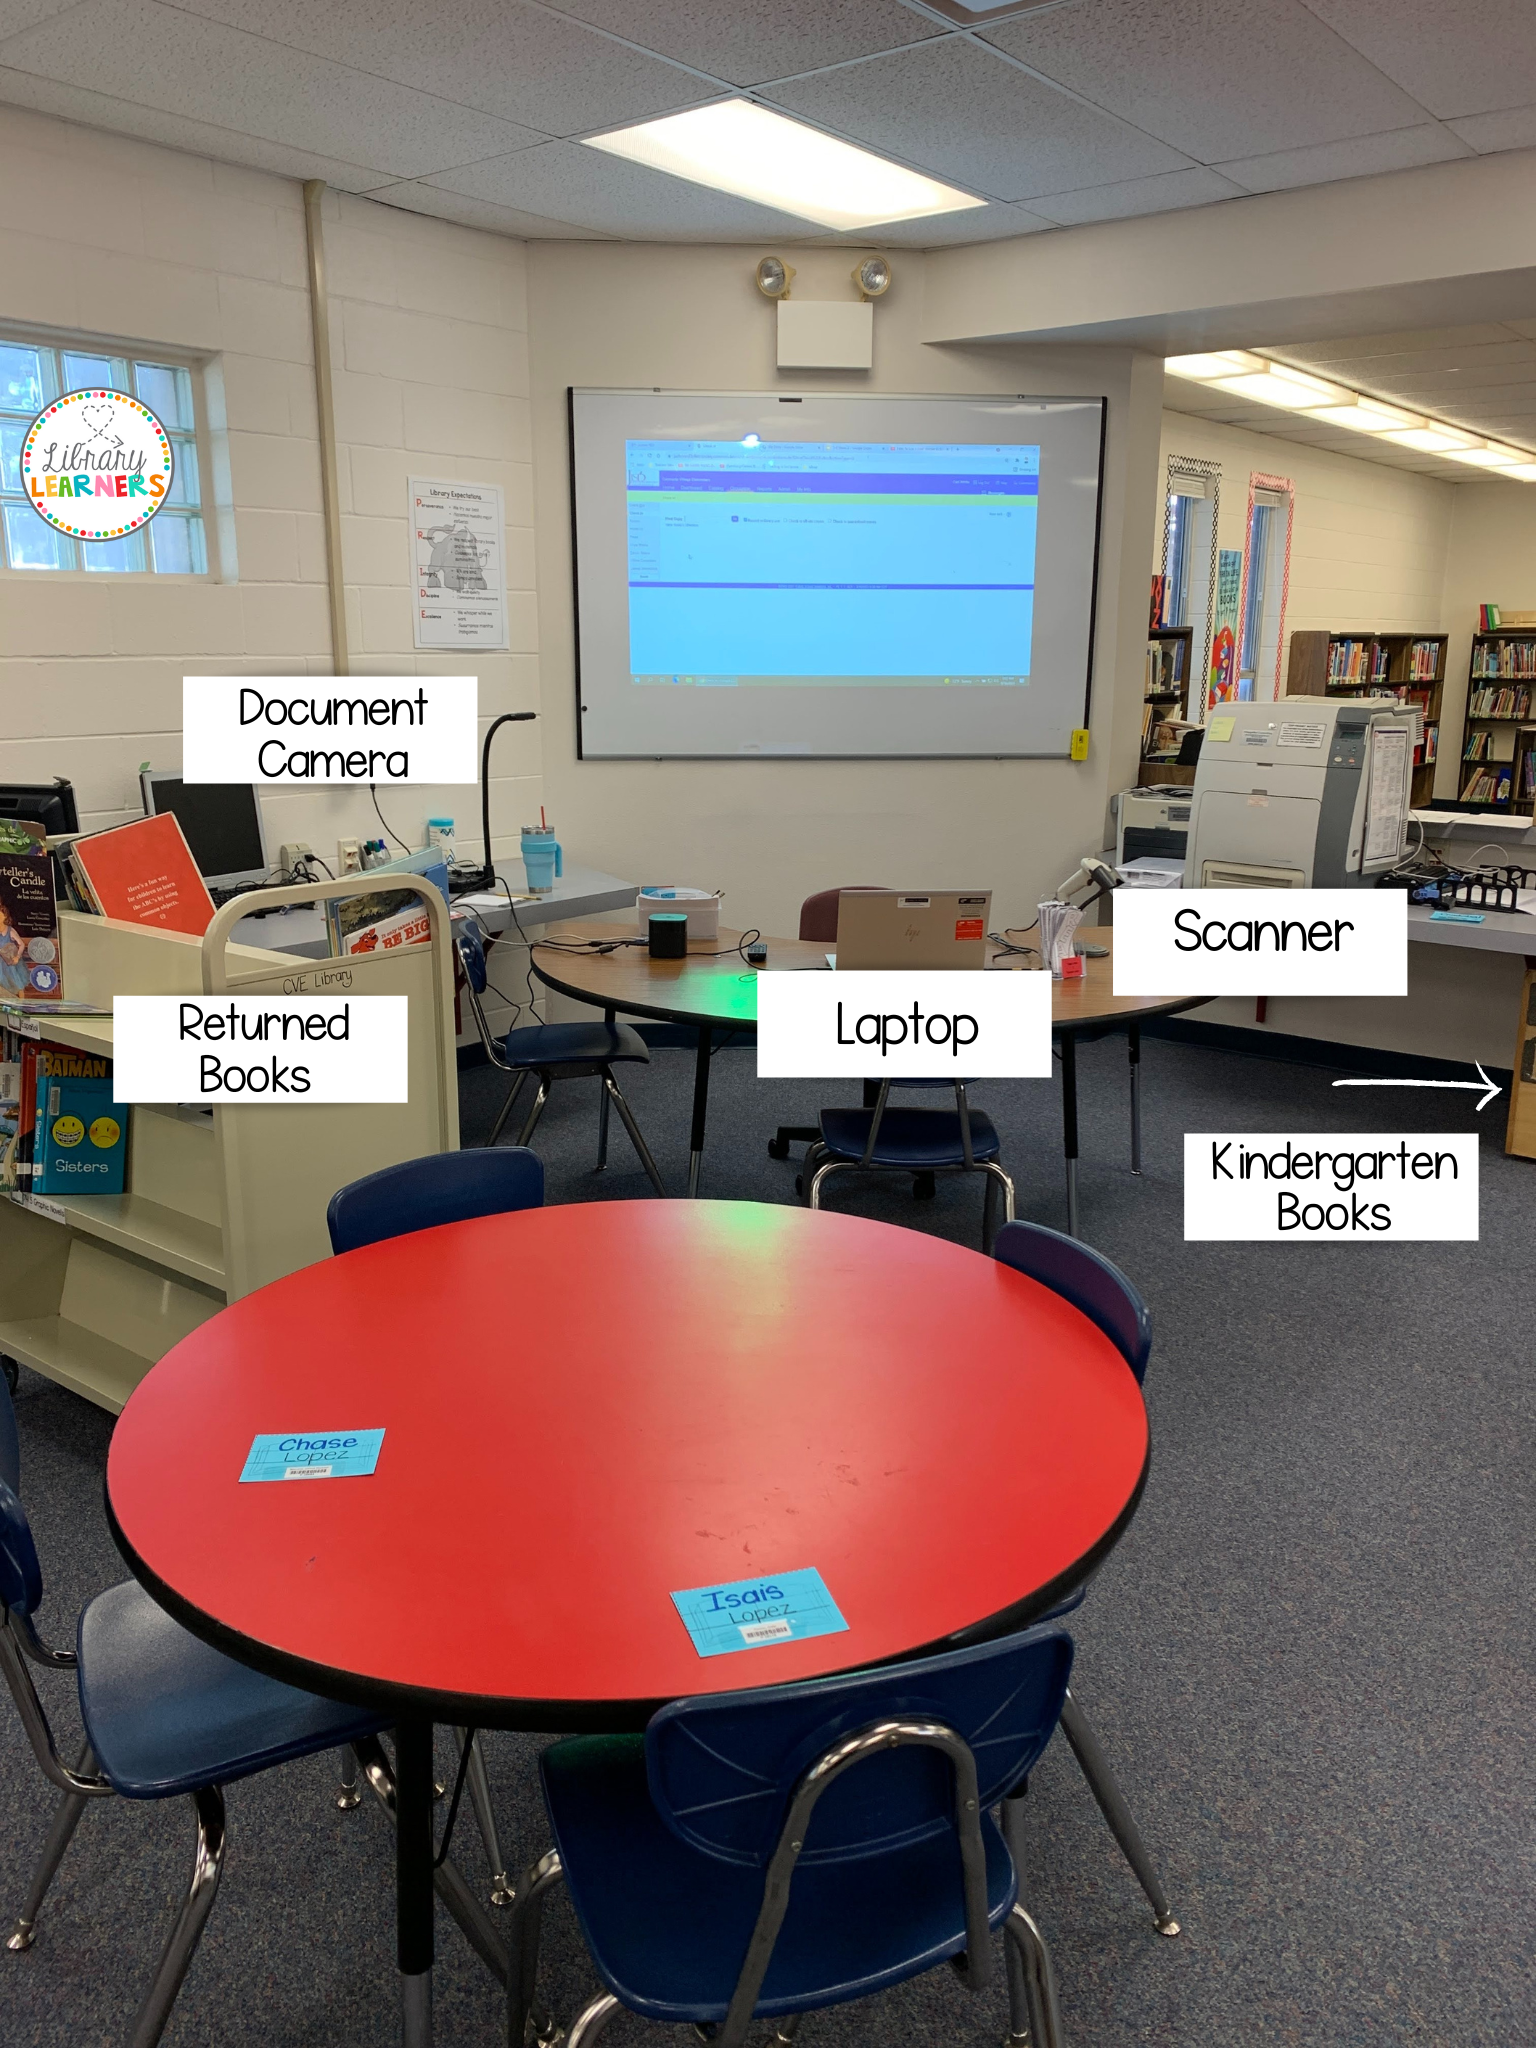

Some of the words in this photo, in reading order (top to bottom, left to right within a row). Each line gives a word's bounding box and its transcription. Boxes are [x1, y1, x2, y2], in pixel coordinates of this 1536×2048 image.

[430, 489, 450, 499] Library
[451, 491, 482, 500] Expectations
[1220, 594, 1236, 605] BOOKS
[10, 876, 46, 888] Candle
[127, 883, 144, 893] Here's
[136, 889, 157, 900] children
[162, 882, 176, 890] learn
[141, 898, 158, 908] ABC's
[164, 890, 179, 899] using
[139, 907, 160, 918] common
[382, 932, 402, 948] BE
[404, 918, 430, 940] BIG
[283, 975, 308, 995] CVE
[314, 970, 353, 988] Library
[41, 1050, 106, 1078] BATMAN
[55, 1159, 109, 1173] Sisters
[279, 1437, 358, 1452] Chase
[284, 1450, 349, 1465] Lopez
[701, 1584, 785, 1613] Isais
[728, 1604, 797, 1625] Lopez
